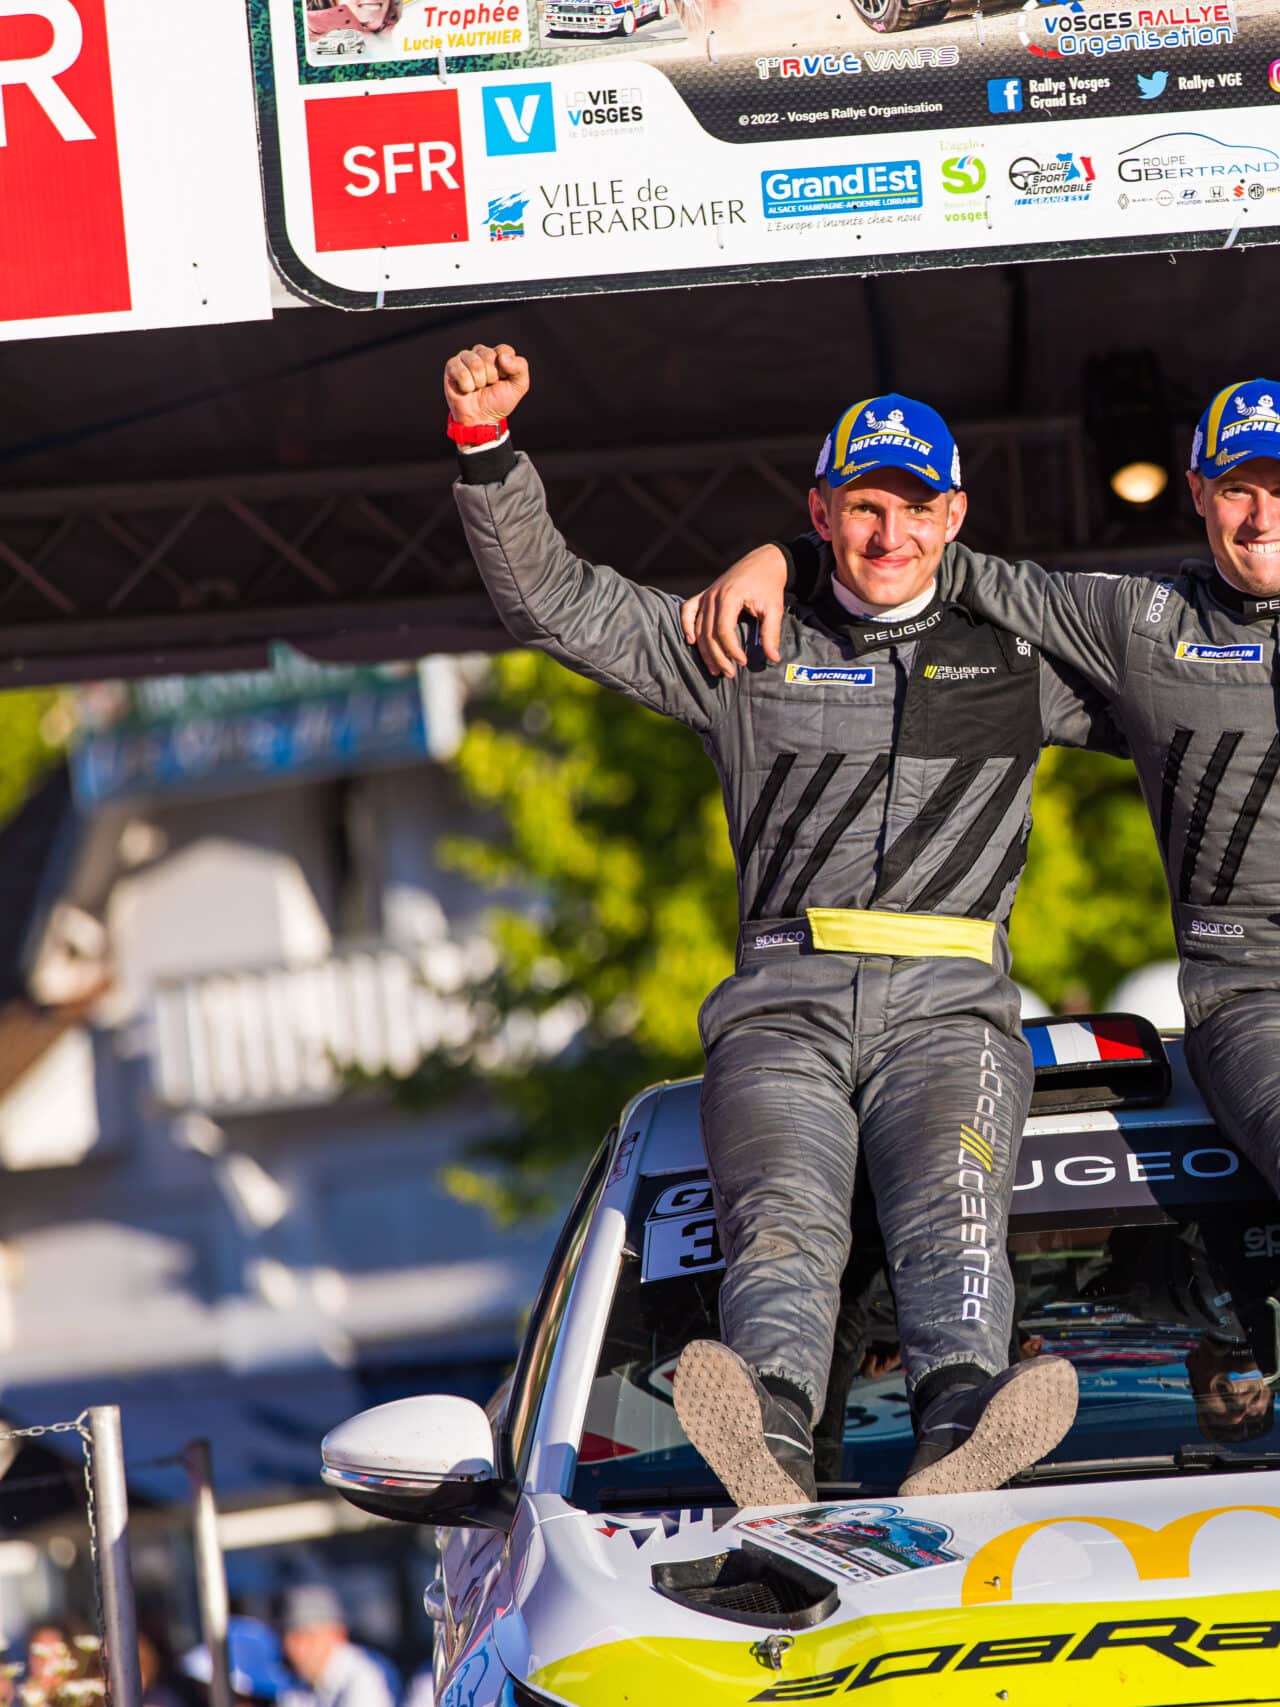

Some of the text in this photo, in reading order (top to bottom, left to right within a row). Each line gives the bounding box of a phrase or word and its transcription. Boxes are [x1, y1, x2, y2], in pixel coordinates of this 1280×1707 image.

[424, 2, 520, 30] Trophée
[1044, 4, 1231, 34] VOSGES RALLYE
[403, 29, 523, 52] Lucie VAUTHIER
[1059, 26, 1233, 56] Organisation
[781, 54, 862, 78] RVGE
[1028, 75, 1111, 94] Rallye Vosges
[1178, 72, 1243, 92] Rallye VGE
[588, 88, 618, 106] VIE
[1030, 92, 1088, 109] Grand Est
[567, 106, 644, 127] VOSGES
[750, 113, 780, 126] 2022
[787, 111, 829, 124] Vosges
[831, 106, 867, 122] Rallye
[868, 101, 944, 118] Organisation
[343, 141, 460, 198] SFR
[1040, 160, 1071, 172] LIGUE
[1032, 173, 1067, 185] SPORT
[540, 177, 670, 209] VILLE de
[1025, 182, 1093, 197] AUTOMOBILE
[541, 199, 748, 239] GERARDMER
[768, 204, 797, 216] ALSACE
[848, 433, 932, 456] MICHELIN
[863, 610, 943, 644] PEUGEOT
[1200, 648, 1254, 660] MICHELIN
[810, 670, 867, 683] MICHELIN
[934, 672, 977, 681] SPORT
[936, 665, 998, 675] PEUGEOT
[1190, 918, 1245, 937] sparco
[753, 929, 806, 949] sparco
[957, 1027, 1007, 1324] PEUGEOT SPORT
